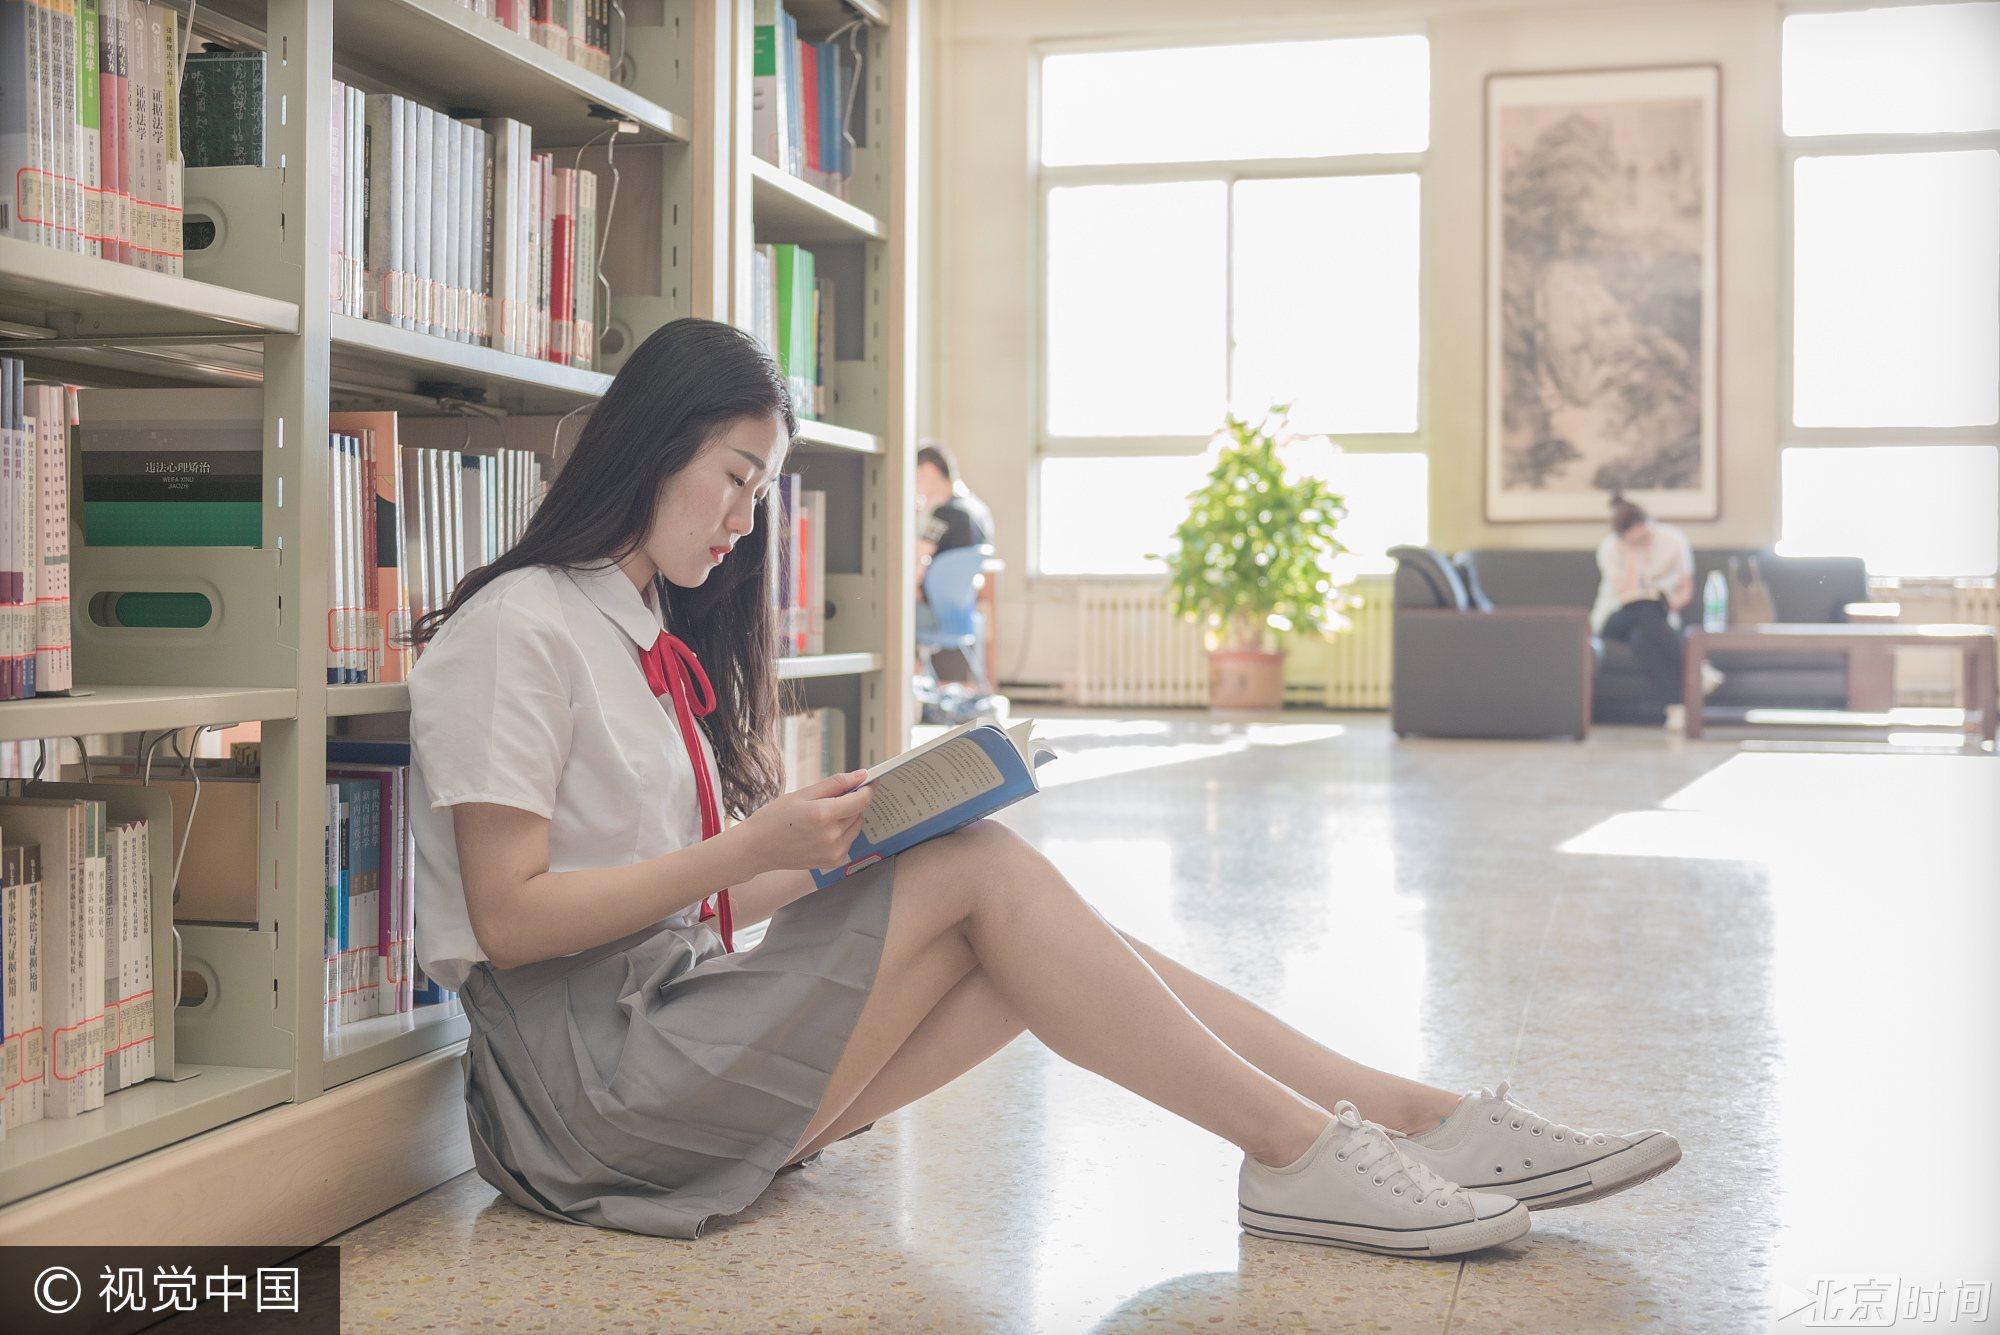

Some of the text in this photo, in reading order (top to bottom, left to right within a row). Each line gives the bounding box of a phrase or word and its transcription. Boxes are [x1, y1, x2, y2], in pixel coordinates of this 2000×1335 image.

[40, 10, 50, 88] 简明证据法学
[52, 15, 62, 110] 简明证据法学
[64, 20, 74, 113] 简明证据法学
[85, 20, 95, 72] 证据法学
[136, 84, 146, 140] 证据法学
[152, 88, 163, 144] 证据法学
[145, 461, 211, 473] 违法心理矫治
[8, 888, 16, 998] 刑事诉讼与证据运用
[29, 885, 38, 993] 刑事诉讼与证据运用
